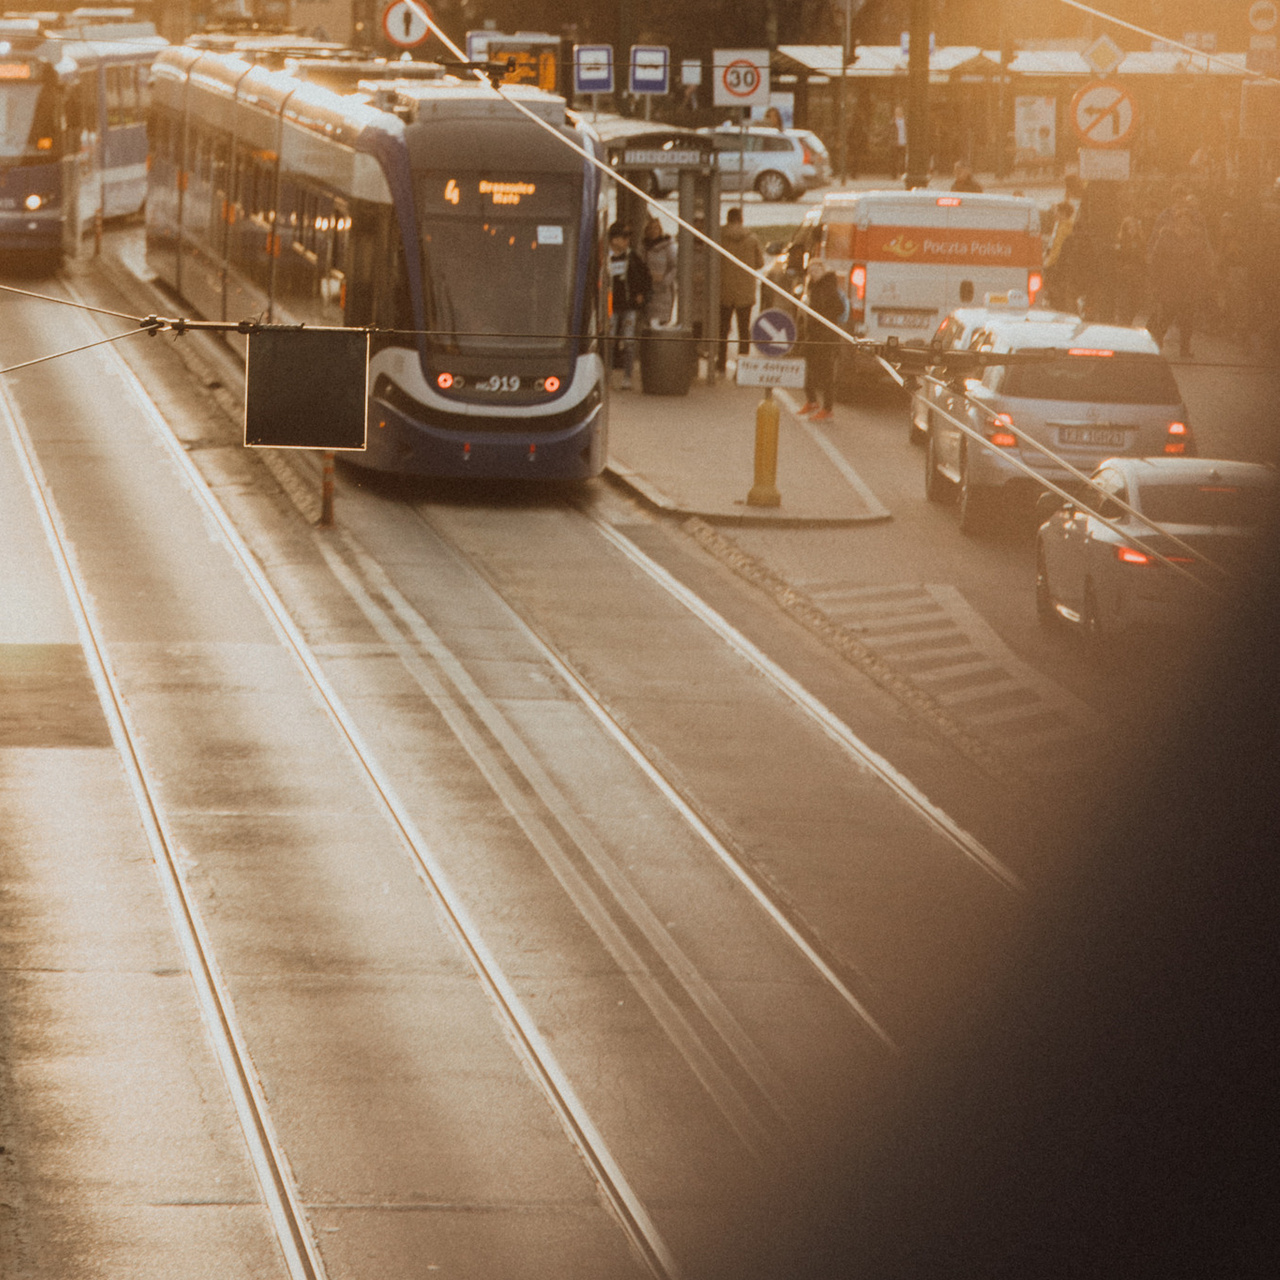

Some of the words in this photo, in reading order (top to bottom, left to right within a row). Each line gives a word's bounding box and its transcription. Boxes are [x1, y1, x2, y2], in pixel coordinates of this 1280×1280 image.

[729, 69, 756, 88] 30
[445, 179, 460, 205] 4
[923, 239, 968, 255] Poczta
[970, 240, 1013, 256] Polska
[489, 375, 520, 392] 919
